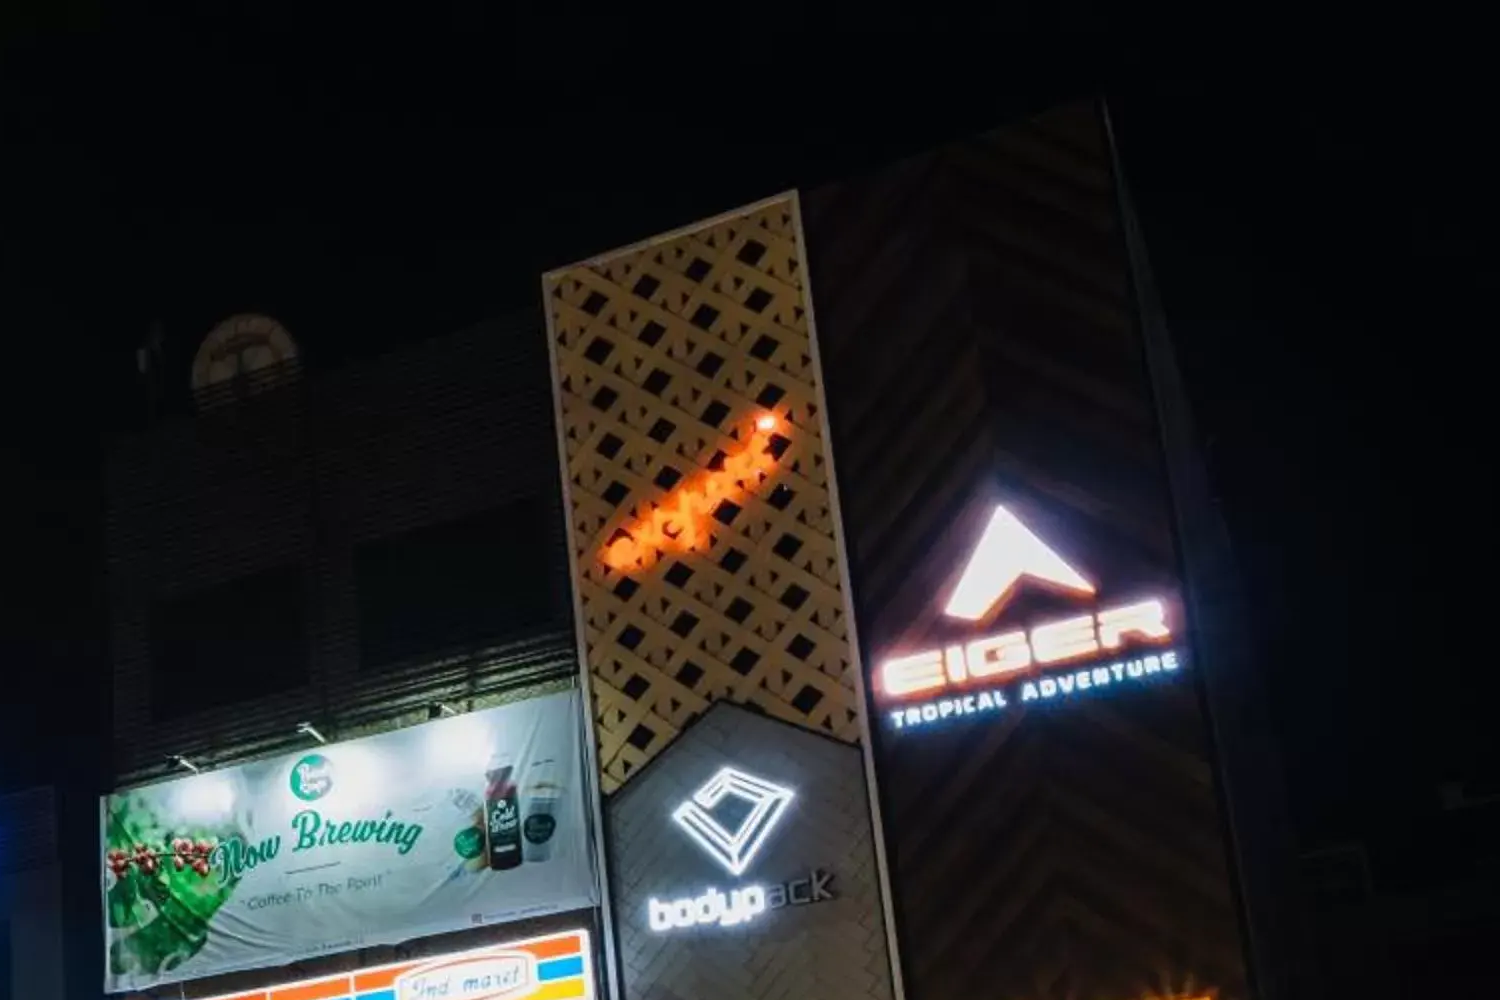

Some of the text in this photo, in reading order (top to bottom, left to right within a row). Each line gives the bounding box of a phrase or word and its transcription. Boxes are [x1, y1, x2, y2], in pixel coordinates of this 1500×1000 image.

[882, 600, 1171, 696] EIGER
[889, 652, 1179, 729] TROPICAL ADVENTURE
[210, 834, 281, 886] Now
[291, 808, 424, 856] Brewing
[649, 869, 835, 931] bodypack
